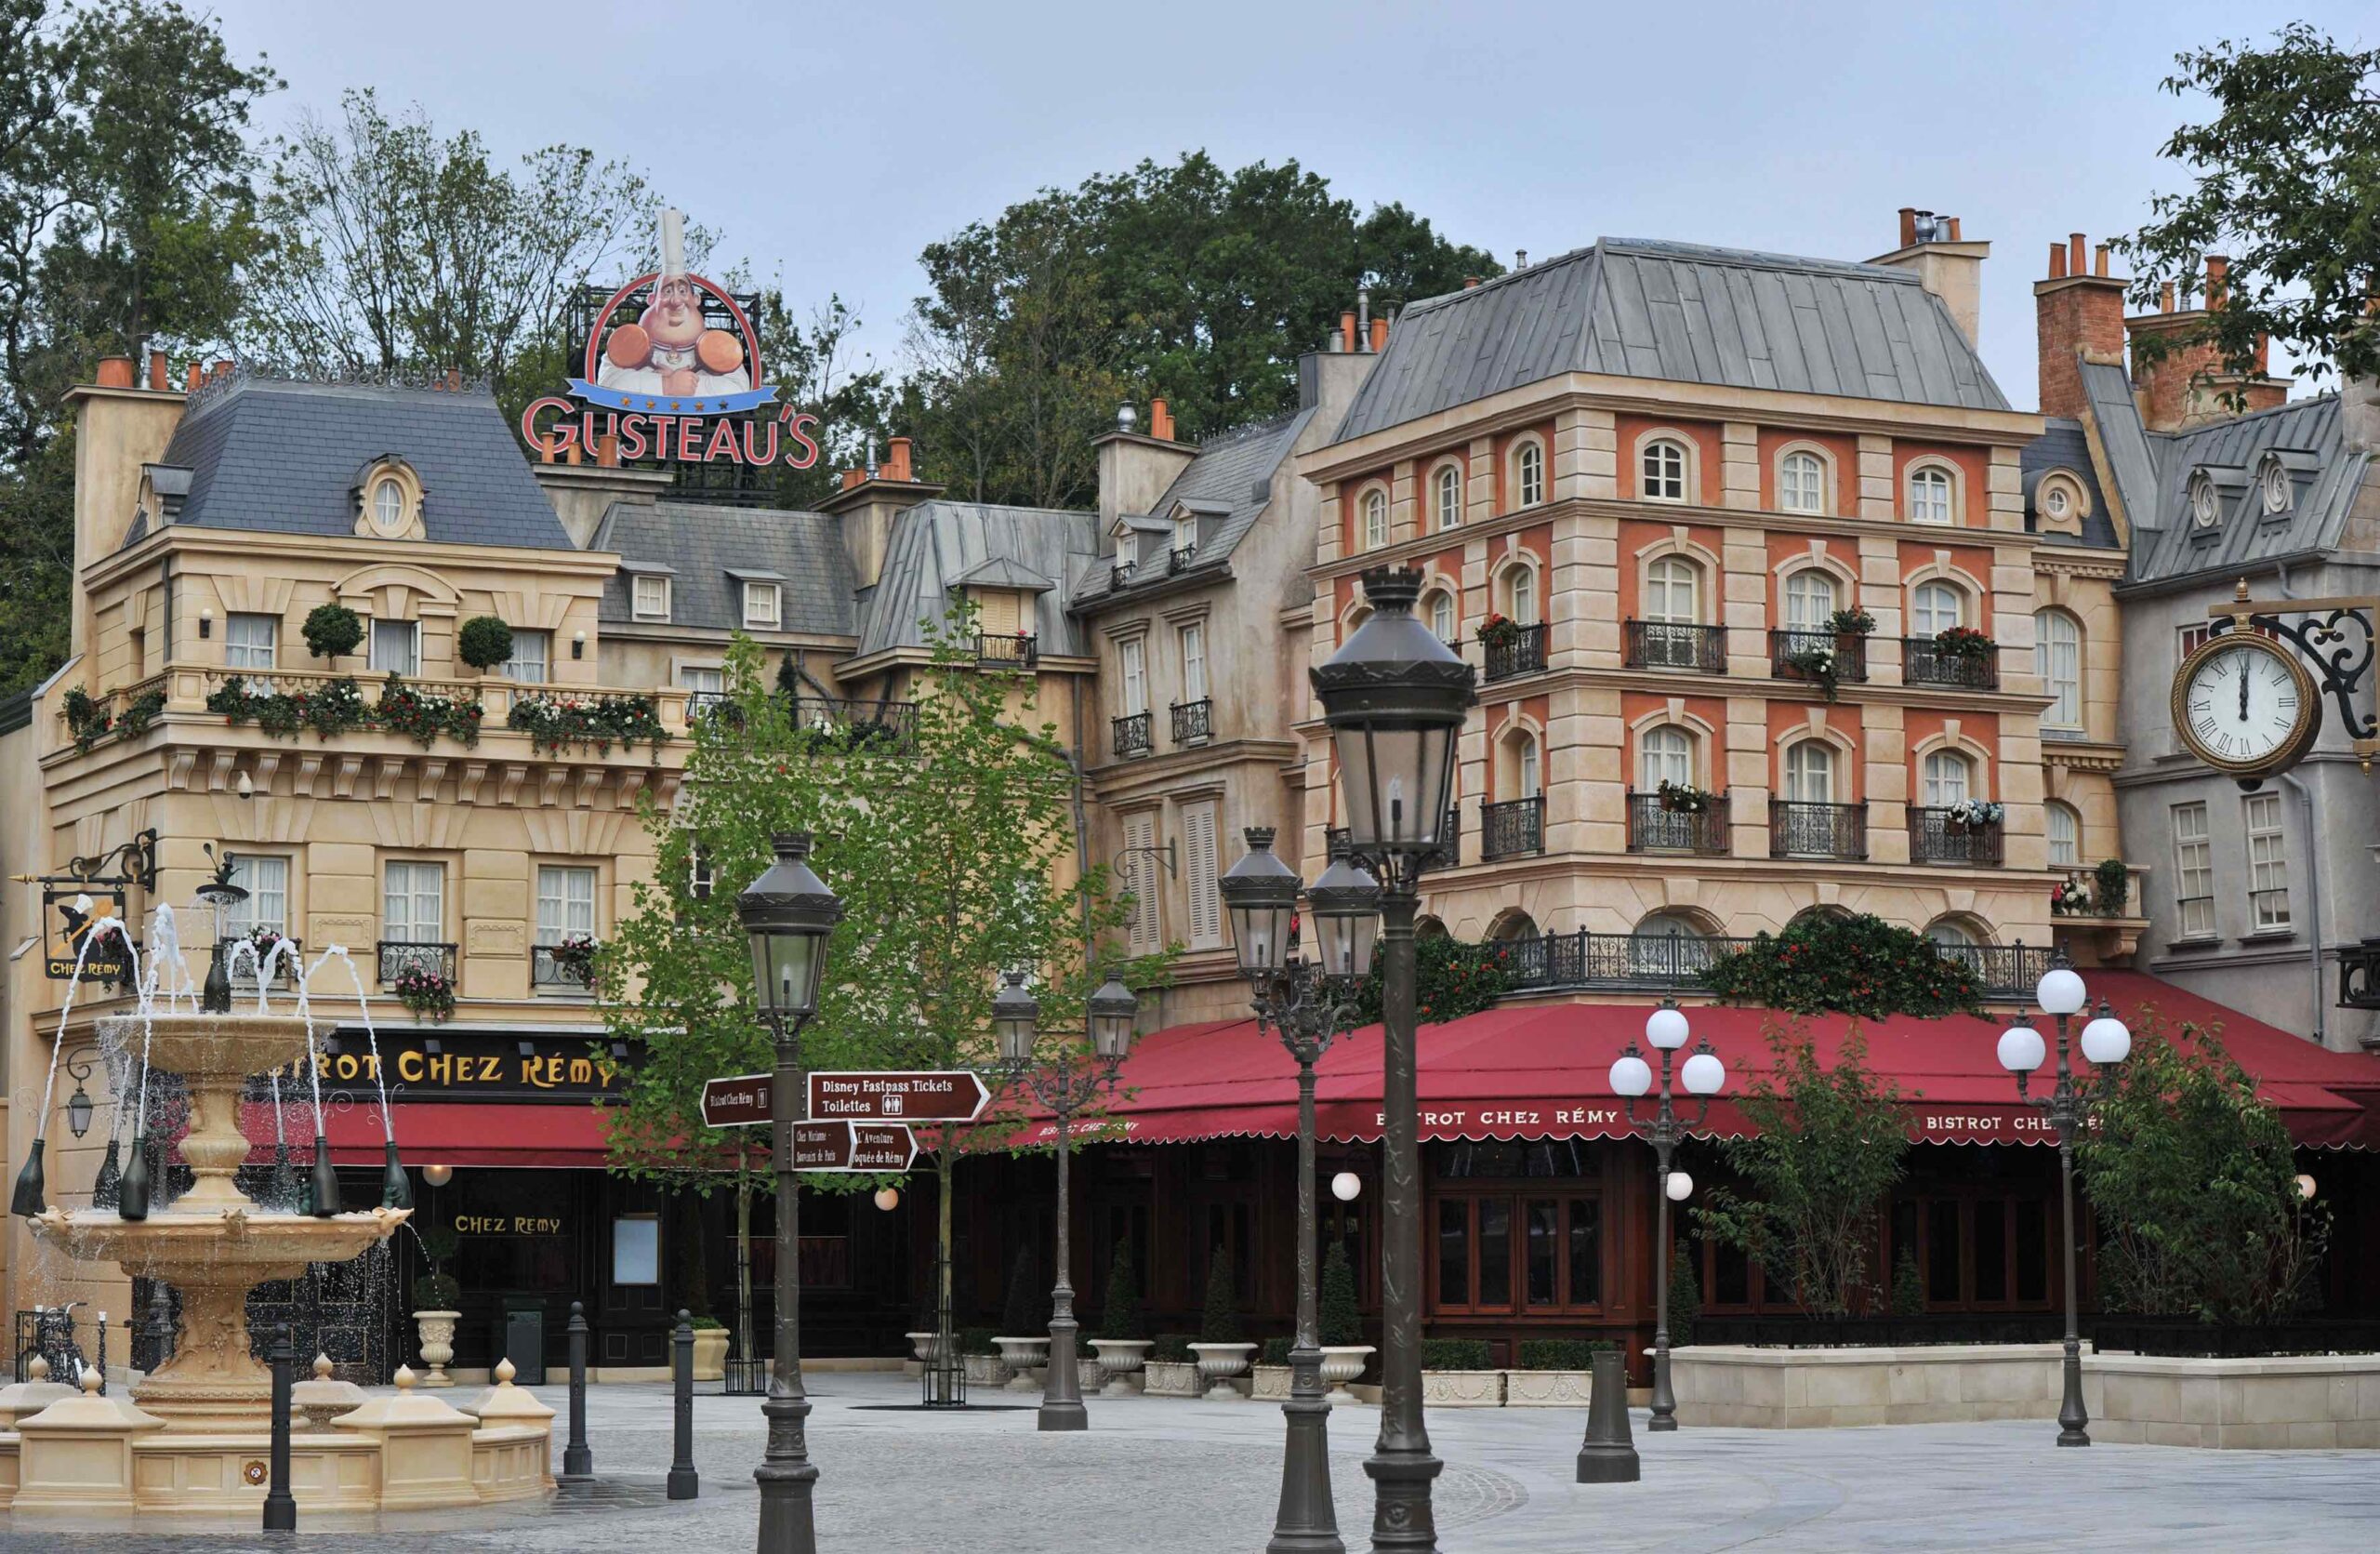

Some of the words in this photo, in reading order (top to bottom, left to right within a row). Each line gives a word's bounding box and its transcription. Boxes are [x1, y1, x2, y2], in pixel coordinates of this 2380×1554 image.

[522, 396, 820, 470] GUSTEAU'S
[398, 1050, 503, 1086] CHEZ
[521, 1052, 617, 1088] RÉMY
[822, 1081, 859, 1096] Disney
[863, 1080, 909, 1095] Fastpass
[912, 1080, 953, 1093] Tickets
[822, 1098, 871, 1112] Toilettes
[1376, 1111, 1466, 1125] BROT
[1480, 1110, 1540, 1124] CHEZ
[1555, 1107, 1619, 1123] RÉMY
[1926, 1116, 2002, 1129] BISTROT
[2014, 1117, 2056, 1130] CHE
[857, 1130, 893, 1144] L'Aventure
[853, 1150, 875, 1166] oquée
[876, 1150, 883, 1162] de
[885, 1150, 905, 1166] Rémy
[456, 1215, 506, 1234] CHEZ
